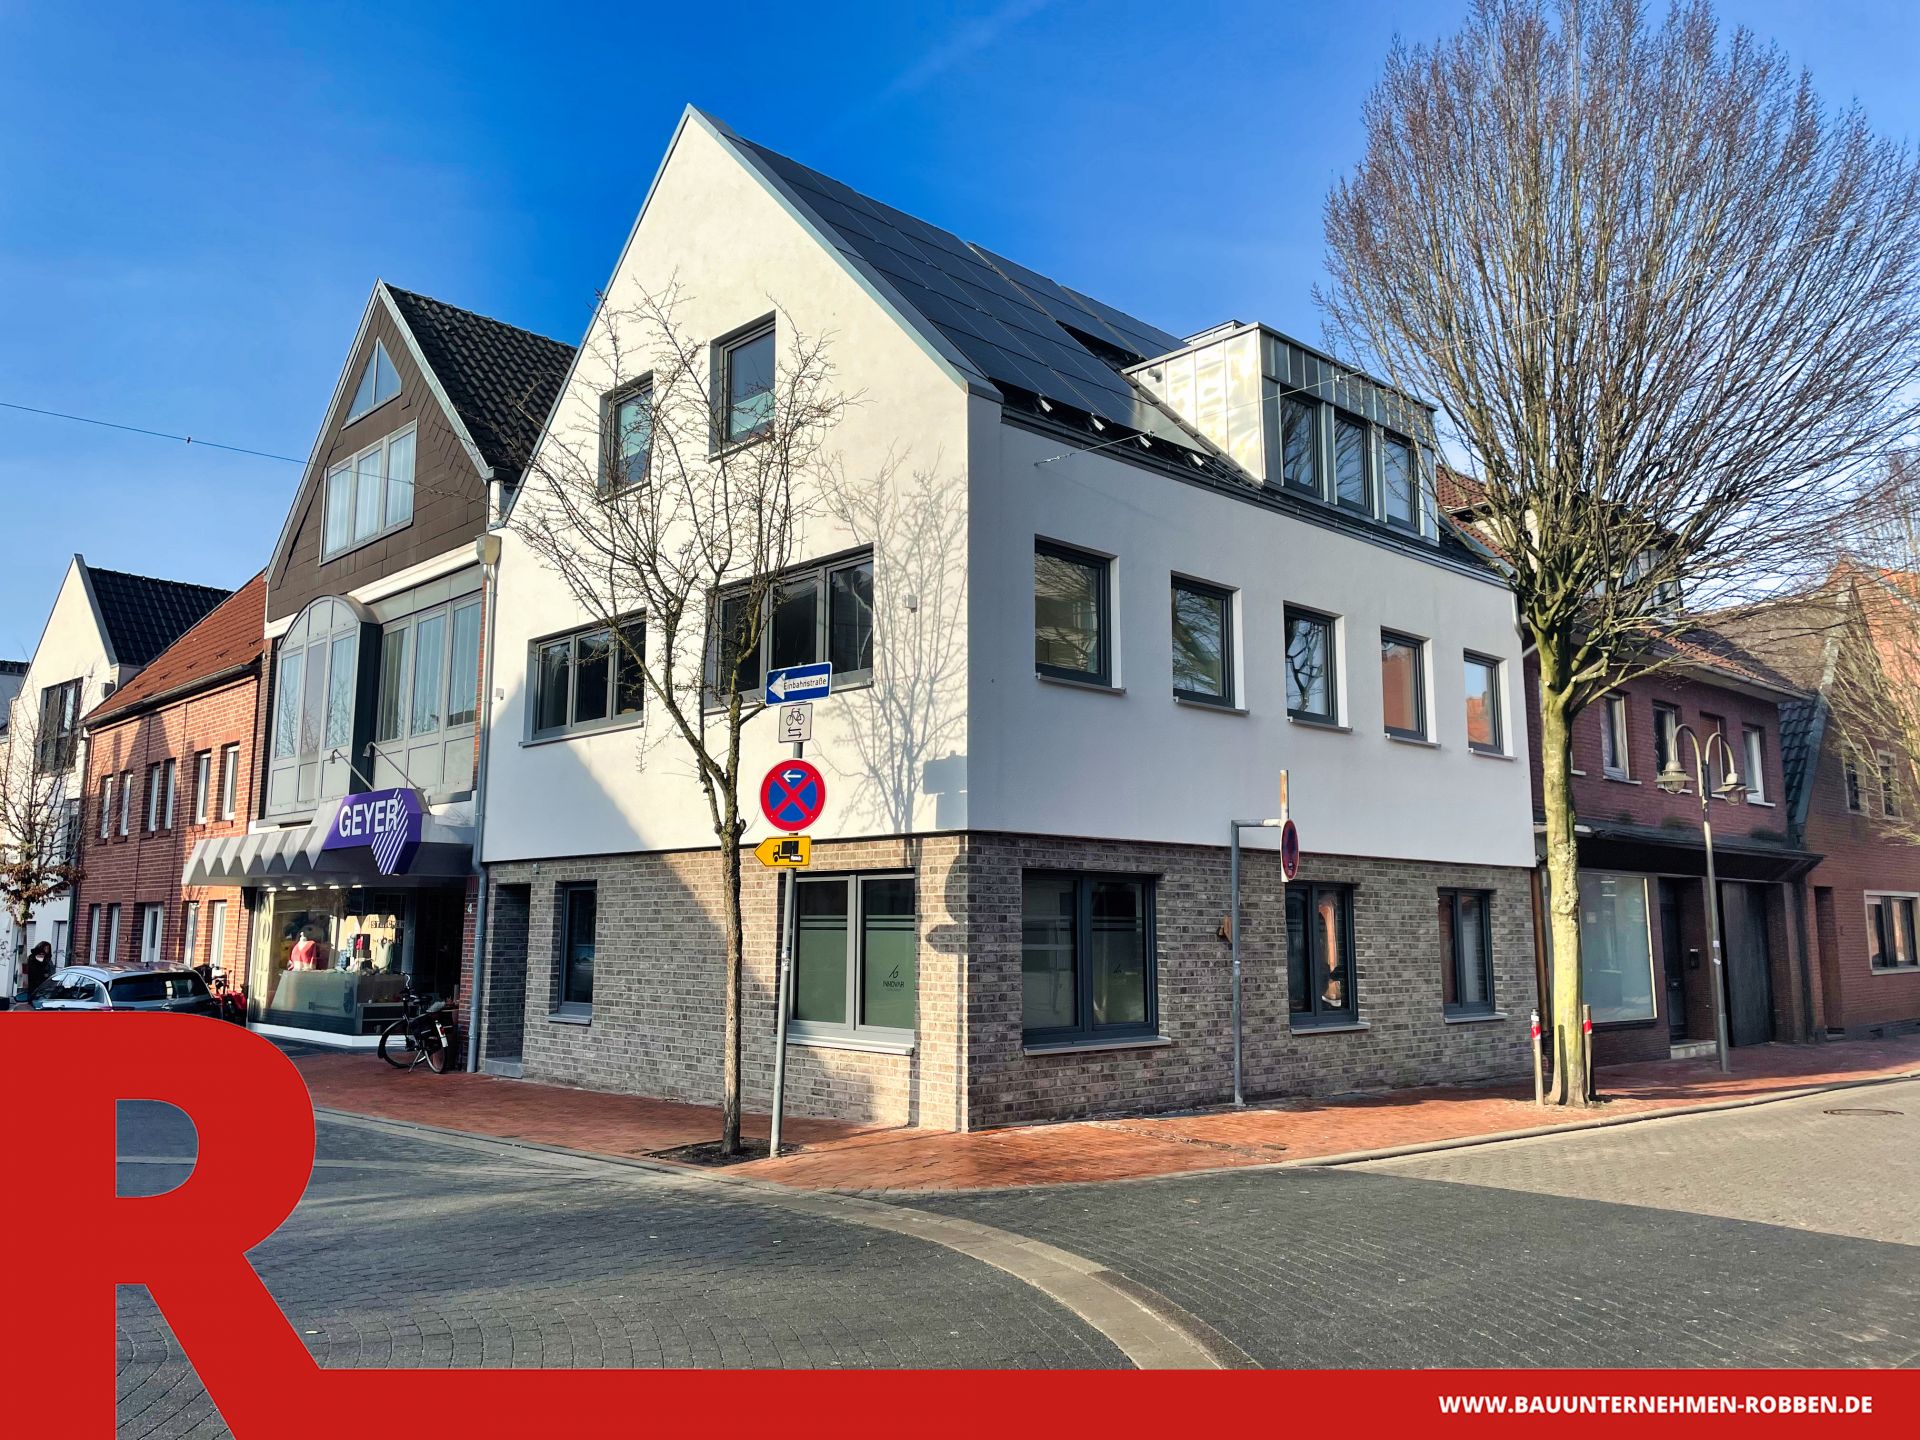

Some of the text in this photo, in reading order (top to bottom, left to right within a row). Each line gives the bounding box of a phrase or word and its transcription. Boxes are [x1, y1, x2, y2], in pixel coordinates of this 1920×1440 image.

[783, 677, 827, 690] Einbahnstraße
[338, 799, 399, 838] GEYER
[467, 902, 473, 914] 4
